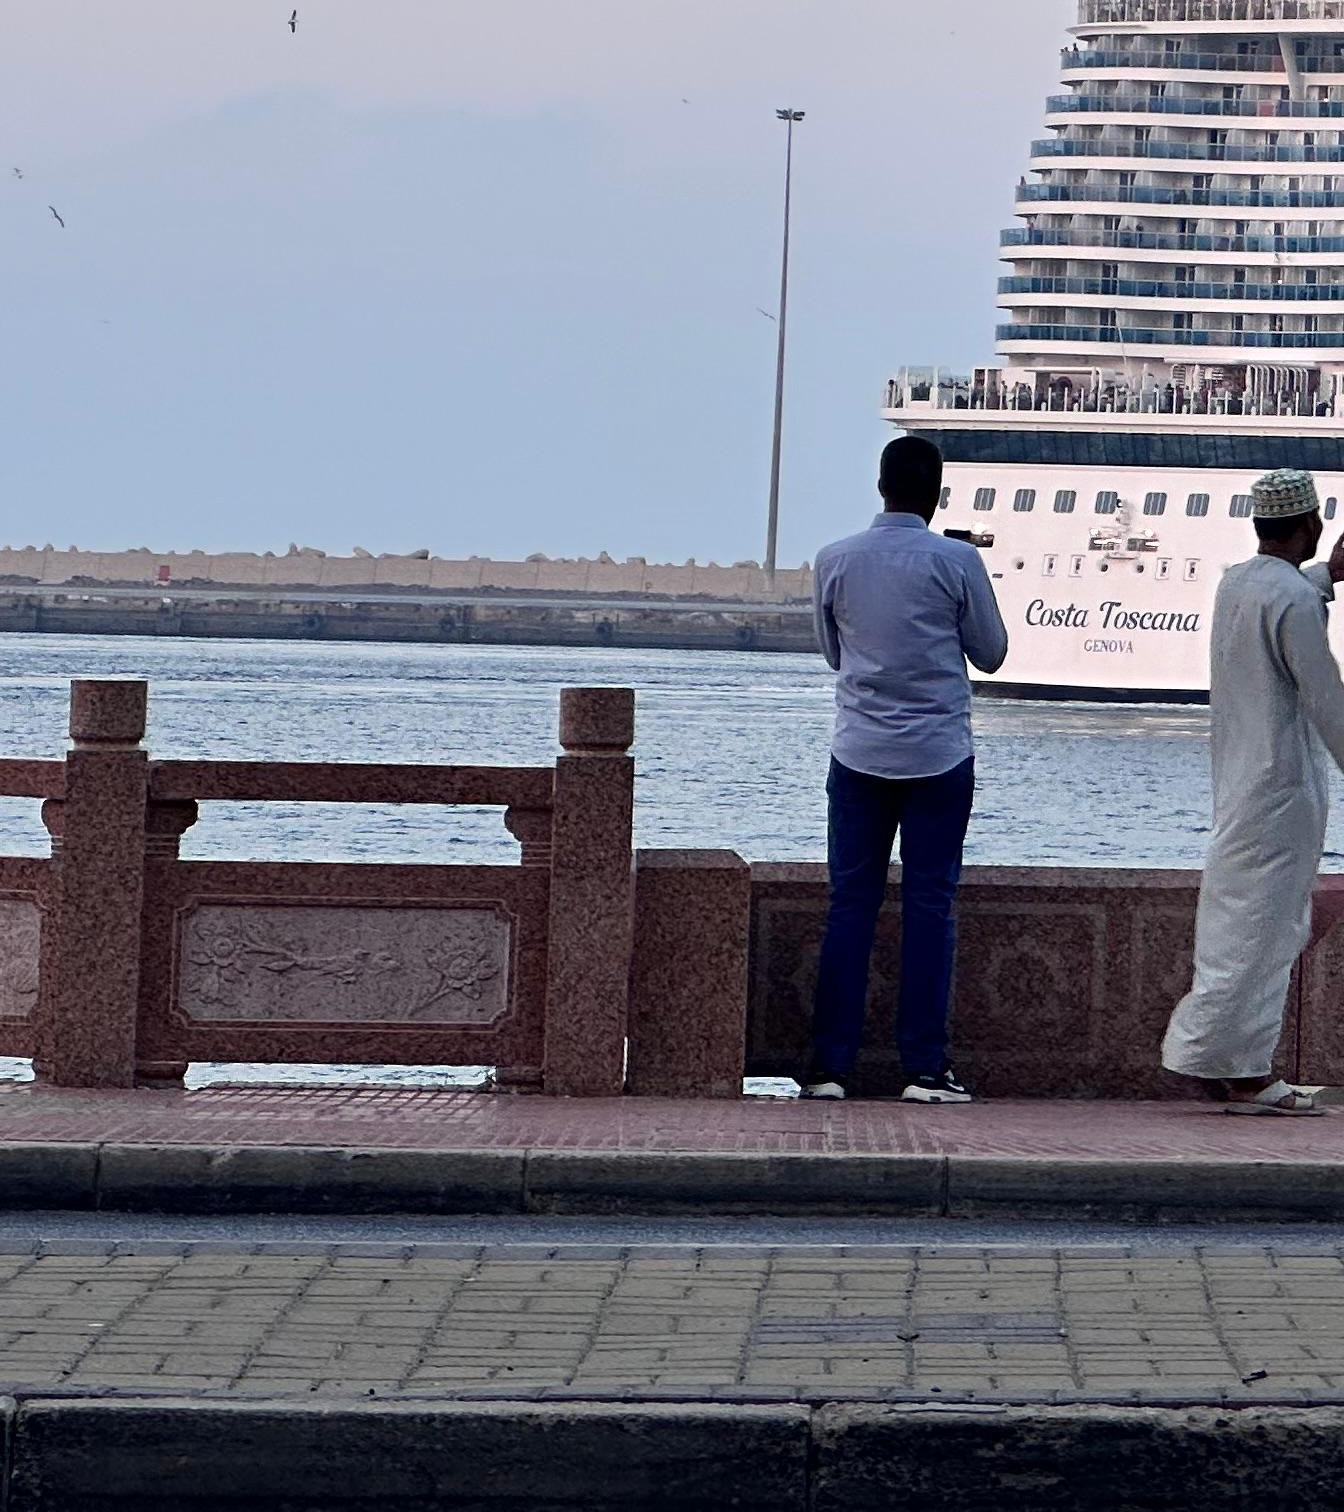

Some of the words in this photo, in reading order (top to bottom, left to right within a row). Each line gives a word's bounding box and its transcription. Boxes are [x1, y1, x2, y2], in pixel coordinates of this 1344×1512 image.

[1025, 599, 1089, 628] Costa
[1099, 601, 1201, 632] Toscana
[1083, 639, 1134, 654] GENOVA
